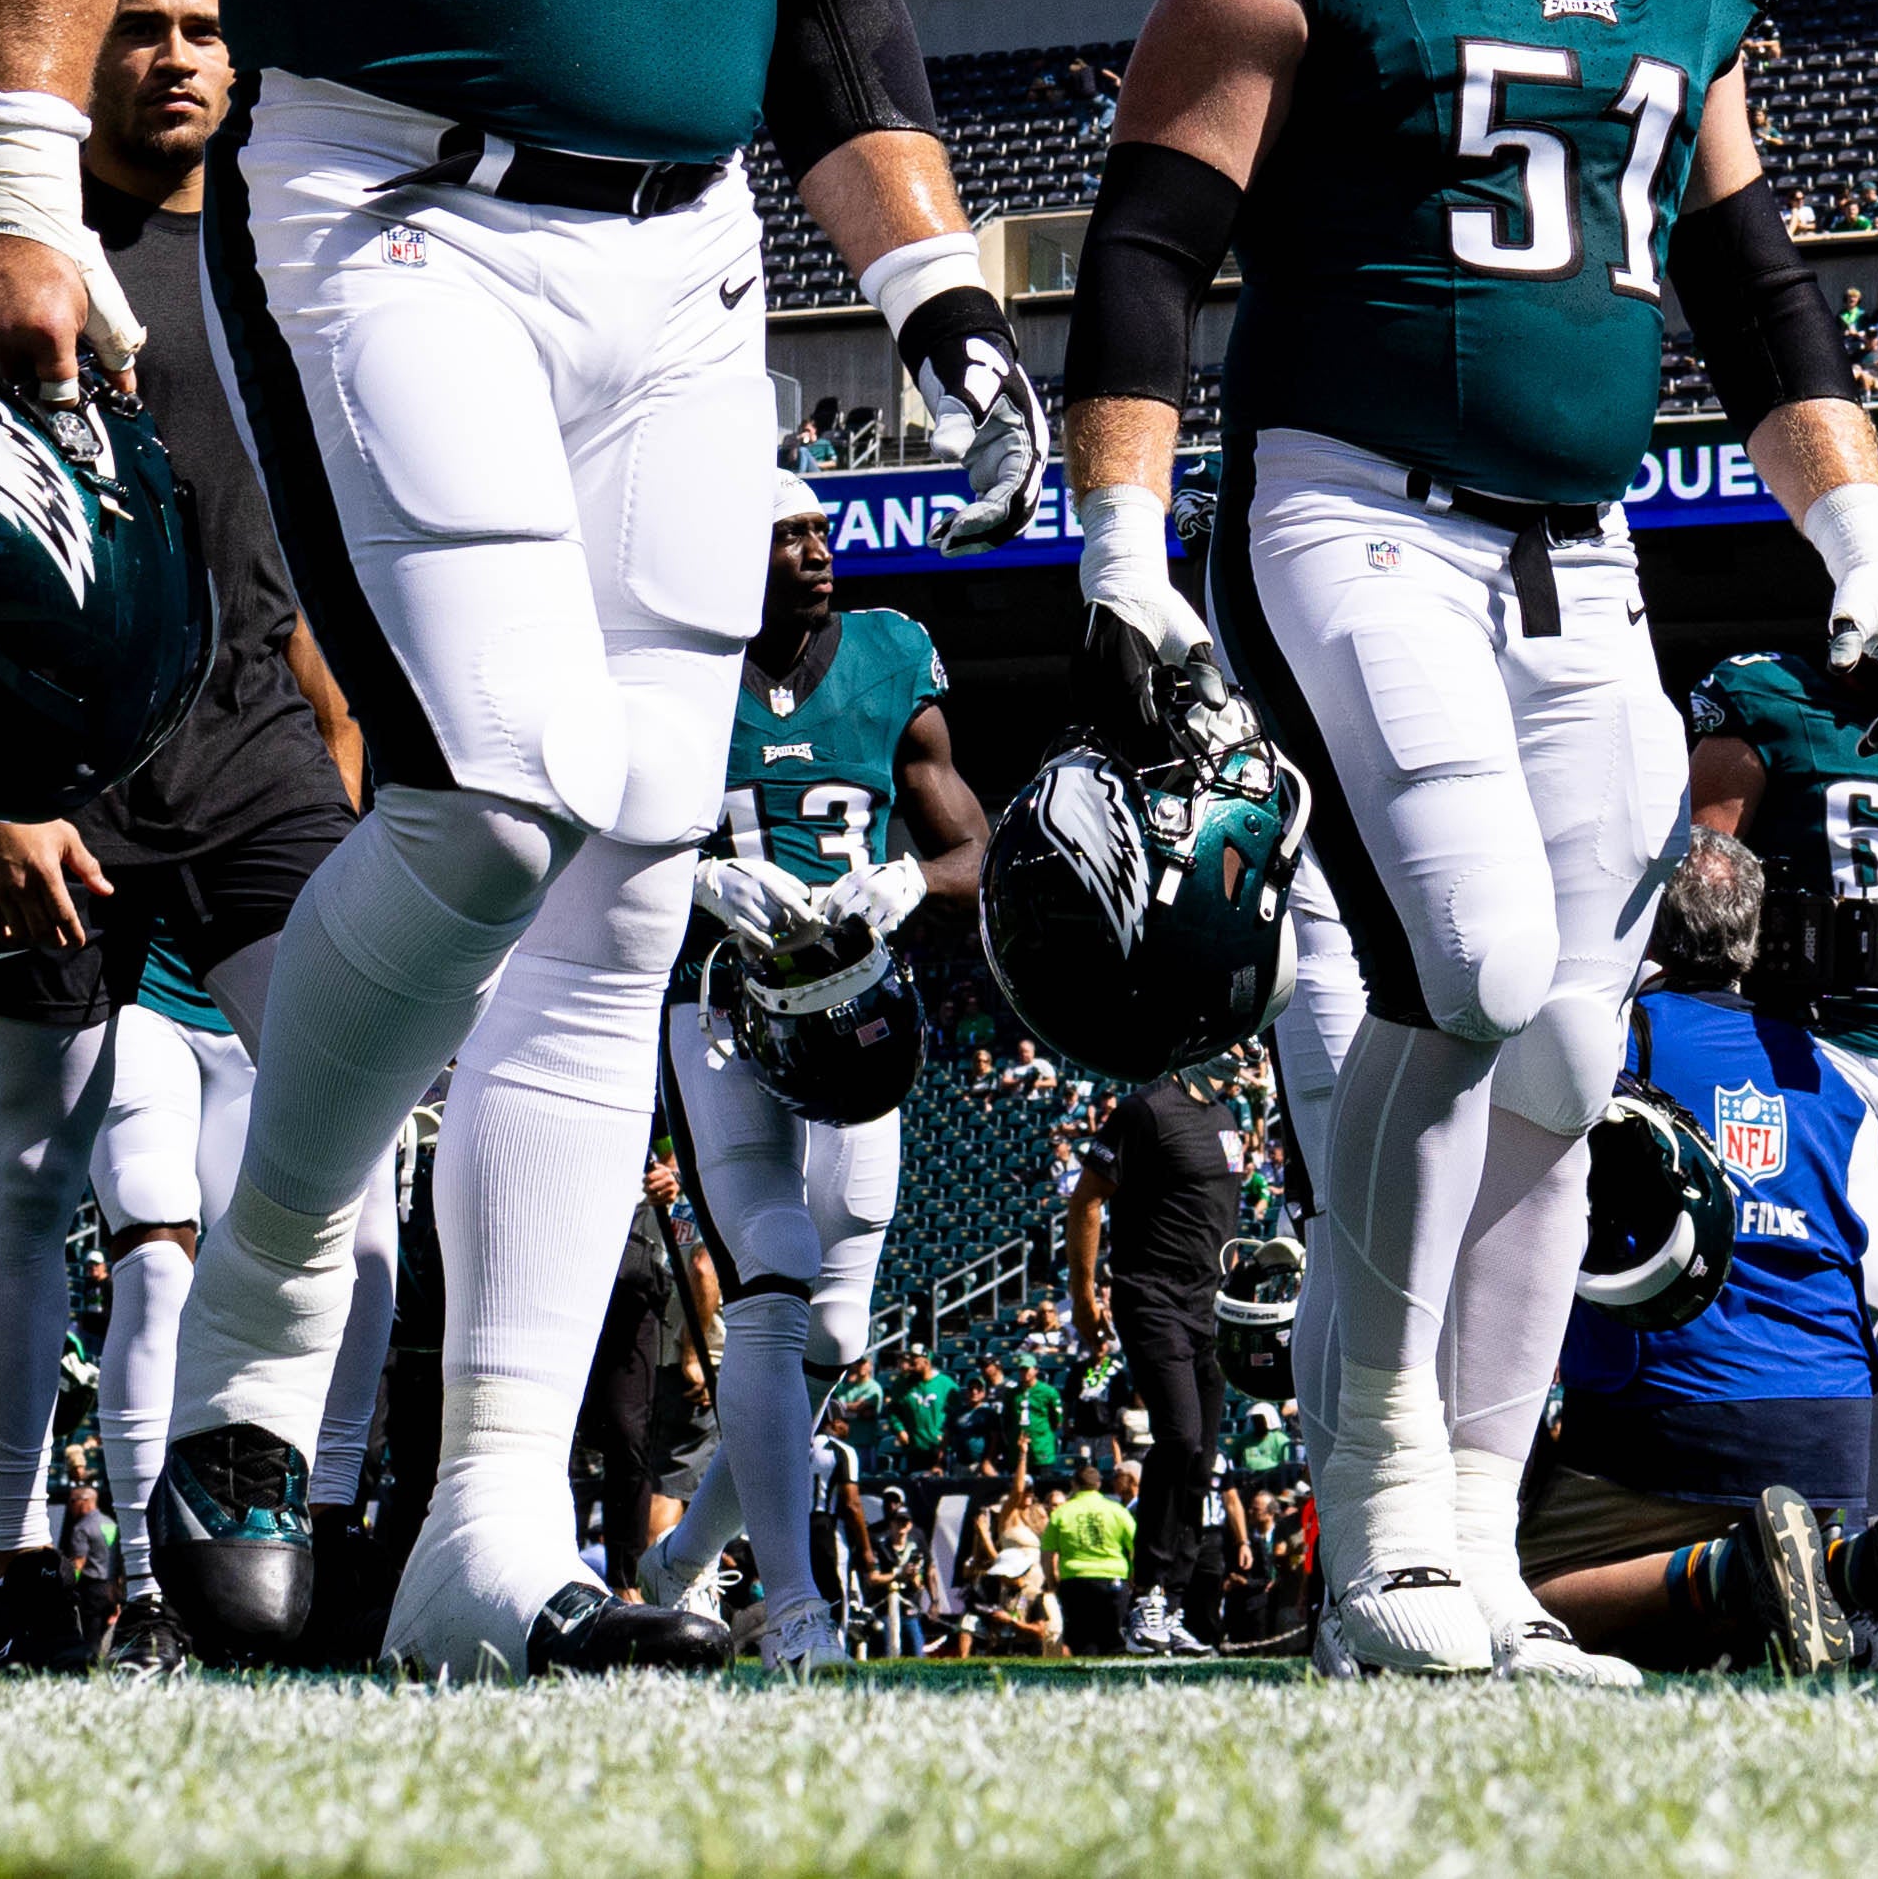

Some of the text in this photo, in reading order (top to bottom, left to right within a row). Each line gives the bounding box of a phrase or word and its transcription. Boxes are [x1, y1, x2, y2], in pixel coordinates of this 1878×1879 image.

[1448, 36, 1690, 304] 51
[391, 243, 423, 263] NFL
[1375, 553, 1398, 565] NFL
[761, 742, 816, 765] EAGLES
[720, 783, 874, 894] 13
[1725, 1124, 1777, 1170] NFL
[1741, 1200, 1811, 1240] FILMS
